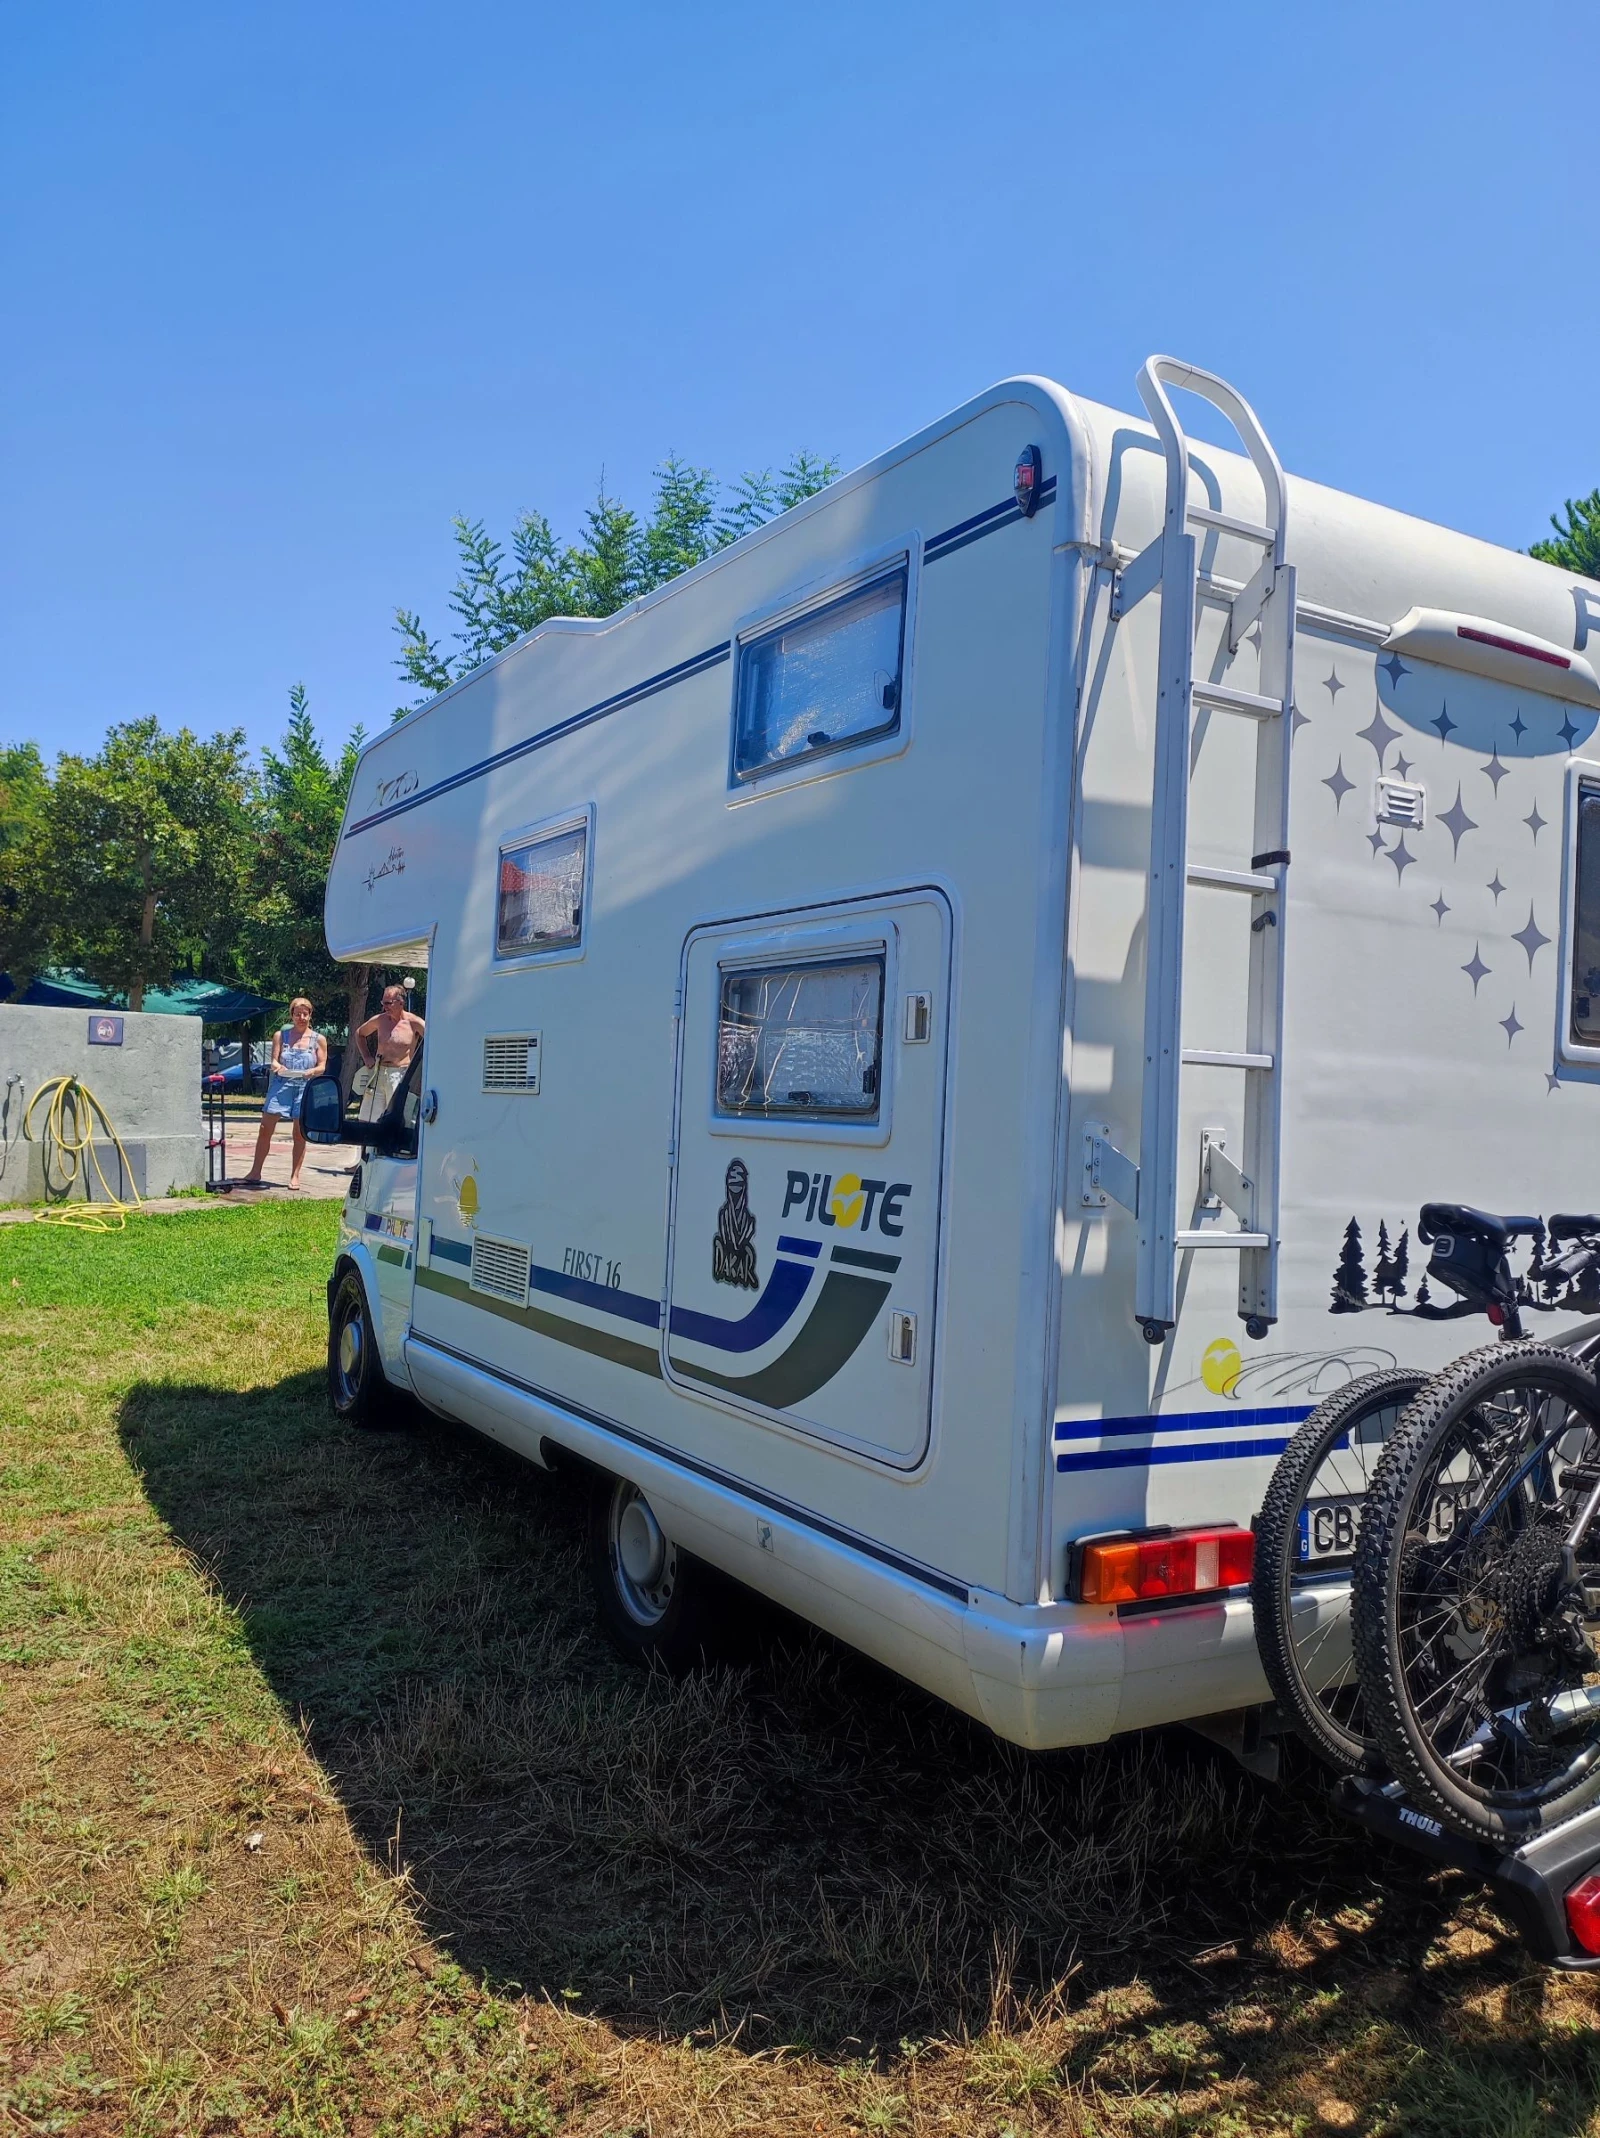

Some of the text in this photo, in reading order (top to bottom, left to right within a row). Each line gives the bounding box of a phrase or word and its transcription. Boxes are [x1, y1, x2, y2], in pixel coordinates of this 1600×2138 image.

[563, 1247, 621, 1289] FIRST 16
[714, 1238, 757, 1285] DAKAR
[1399, 1808, 1442, 1836] THULE
